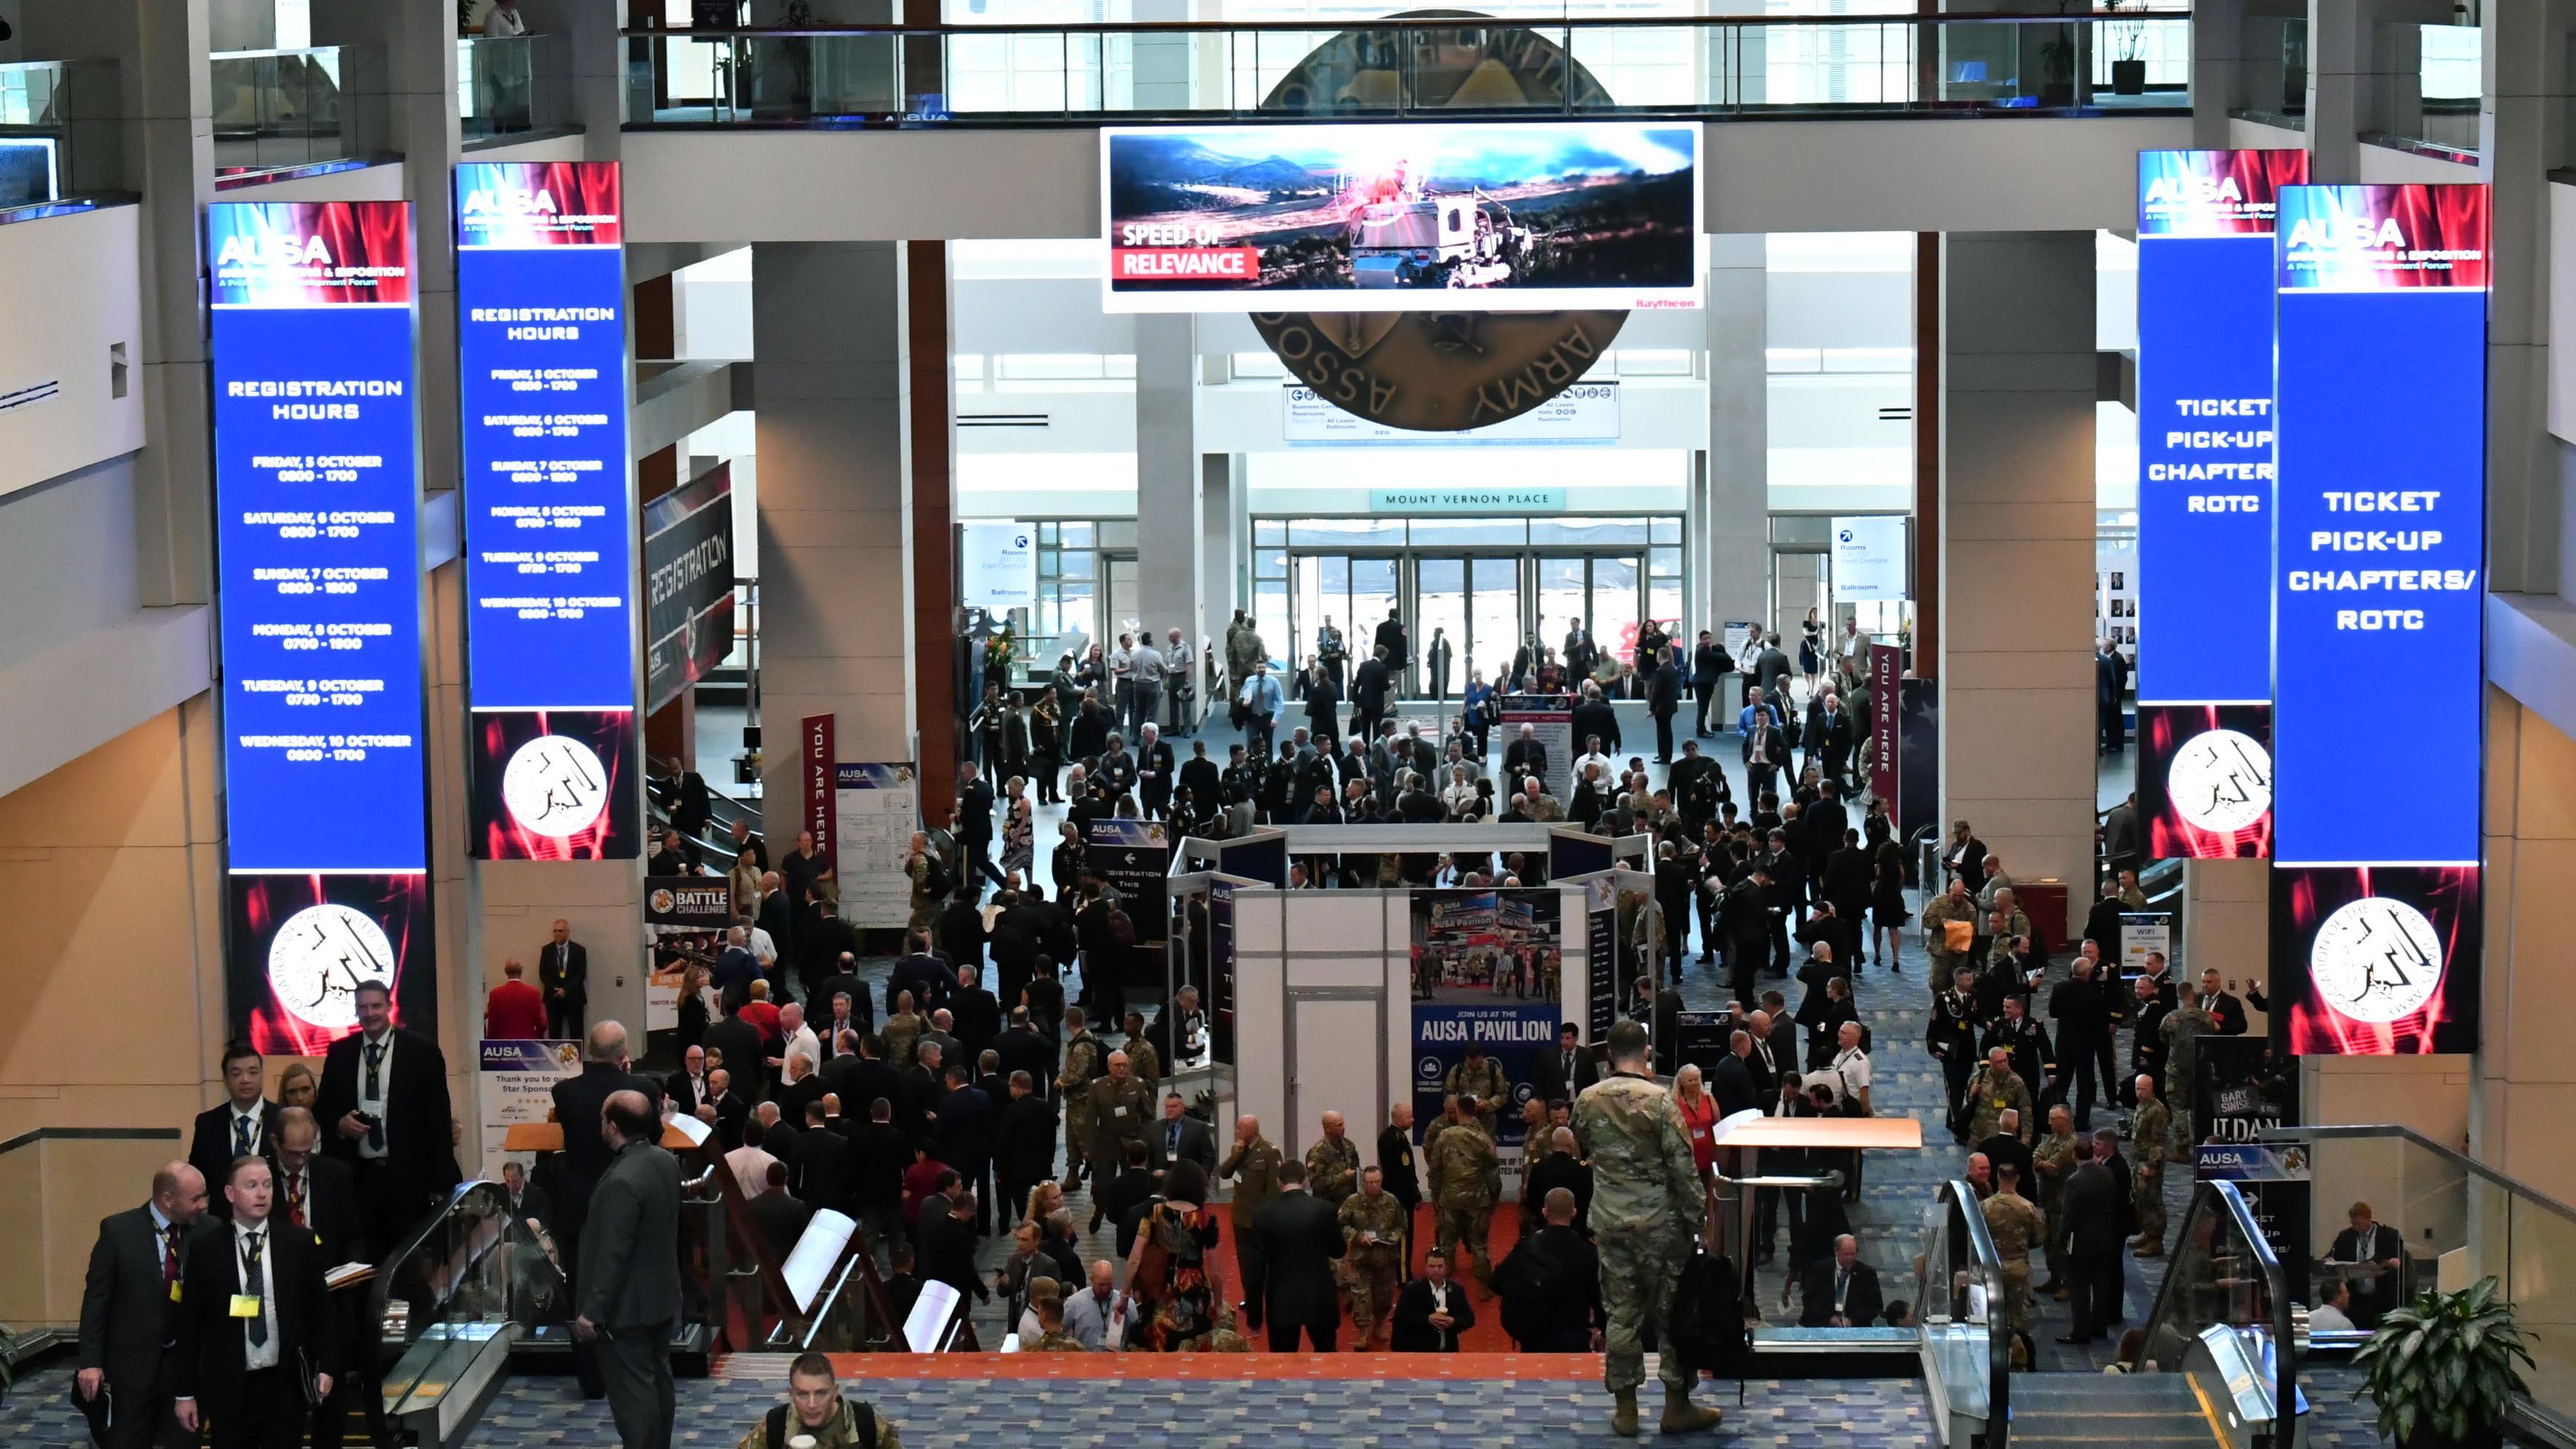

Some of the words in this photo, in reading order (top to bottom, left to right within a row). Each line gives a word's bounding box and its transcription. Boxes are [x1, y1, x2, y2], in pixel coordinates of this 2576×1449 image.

[2145, 178, 2242, 202] AUSA
[463, 189, 557, 213] AUSA
[2244, 204, 2276, 212] EXPOS
[1123, 224, 1190, 245] SPEED
[1195, 224, 1223, 245] OF
[2287, 219, 2405, 248] AUSA
[217, 235, 333, 265] AUSA
[1123, 253, 1245, 274] RELEVANCE
[2422, 263, 2453, 271] Forum
[349, 278, 378, 286] Forum
[1636, 299, 1695, 309] Raytheon
[472, 307, 615, 322] REGISTRATION
[509, 326, 579, 340] HOURS
[1471, 323, 1595, 420] ARMY
[228, 381, 402, 397] REGISTRATION
[273, 403, 359, 419] HOURS
[2176, 399, 2271, 416] TICKET
[2167, 431, 2272, 448] PICK-UP
[253, 457, 304, 469] FRIDAY,
[307, 457, 315, 467] 5
[317, 456, 382, 467] OCTOBER
[279, 470, 315, 481] 0800
[325, 470, 357, 481] 1700
[2149, 463, 2272, 481] CHAPTER
[1386, 494, 1437, 504] MOUNT
[1443, 494, 1501, 504] VERNON
[1508, 494, 1549, 503] PLACE
[2188, 495, 2259, 513] ROTC
[2323, 491, 2441, 512] TICKET
[244, 513, 316, 525] SATURDAY,
[318, 513, 328, 524] 6
[331, 512, 395, 524] OCTOBER
[280, 526, 317, 537] 0800
[327, 526, 360, 537] 1700
[2311, 531, 2442, 550] PICK-UP
[254, 569, 310, 581] SUNDAY,
[313, 569, 321, 580] 7
[323, 568, 388, 580] OCTOBER
[651, 529, 727, 609] REGISTRATION
[2289, 570, 2476, 591] CHAPTERS/
[2337, 610, 2424, 630] ROTC
[253, 624, 314, 637] MONDAY,
[316, 624, 325, 636] 8
[328, 624, 392, 636] OCTOBER
[1881, 653, 1889, 685] YOU
[242, 680, 305, 692] TUESDAY,
[308, 680, 317, 691] 9
[320, 680, 384, 691] OCTOBER
[287, 694, 320, 705] 0730
[1881, 691, 1889, 723] ARE
[240, 735, 327, 749] WEDNESDAY,
[330, 735, 344, 747] 10
[347, 735, 411, 747] OCTOBER
[814, 723, 823, 759] YOU
[287, 749, 323, 761] 0800
[333, 749, 366, 761] 1700
[1881, 729, 1889, 772] HERE
[839, 770, 868, 778] AUSA
[815, 765, 824, 800] ARE
[816, 806, 826, 853] HERE
[1092, 825, 1121, 834] AUSA
[1107, 869, 1161, 877] GISTRATION
[676, 893, 727, 905] BATTLE
[676, 905, 727, 914] CHALLENGE
[1457, 917, 1493, 928] Pavilion
[1421, 1021, 1469, 1041] AUSA
[1474, 1020, 1552, 1041] PAVILION
[483, 1046, 522, 1057] AUSA
[496, 1075, 521, 1083] Thank
[502, 1085, 520, 1093] Star
[523, 1085, 553, 1094] Sponso
[2221, 1090, 2248, 1103] GARY
[2221, 1099, 2251, 1114] SINISE
[2200, 1153, 2243, 1165] AUSA
[2255, 1215, 2275, 1223] KET
